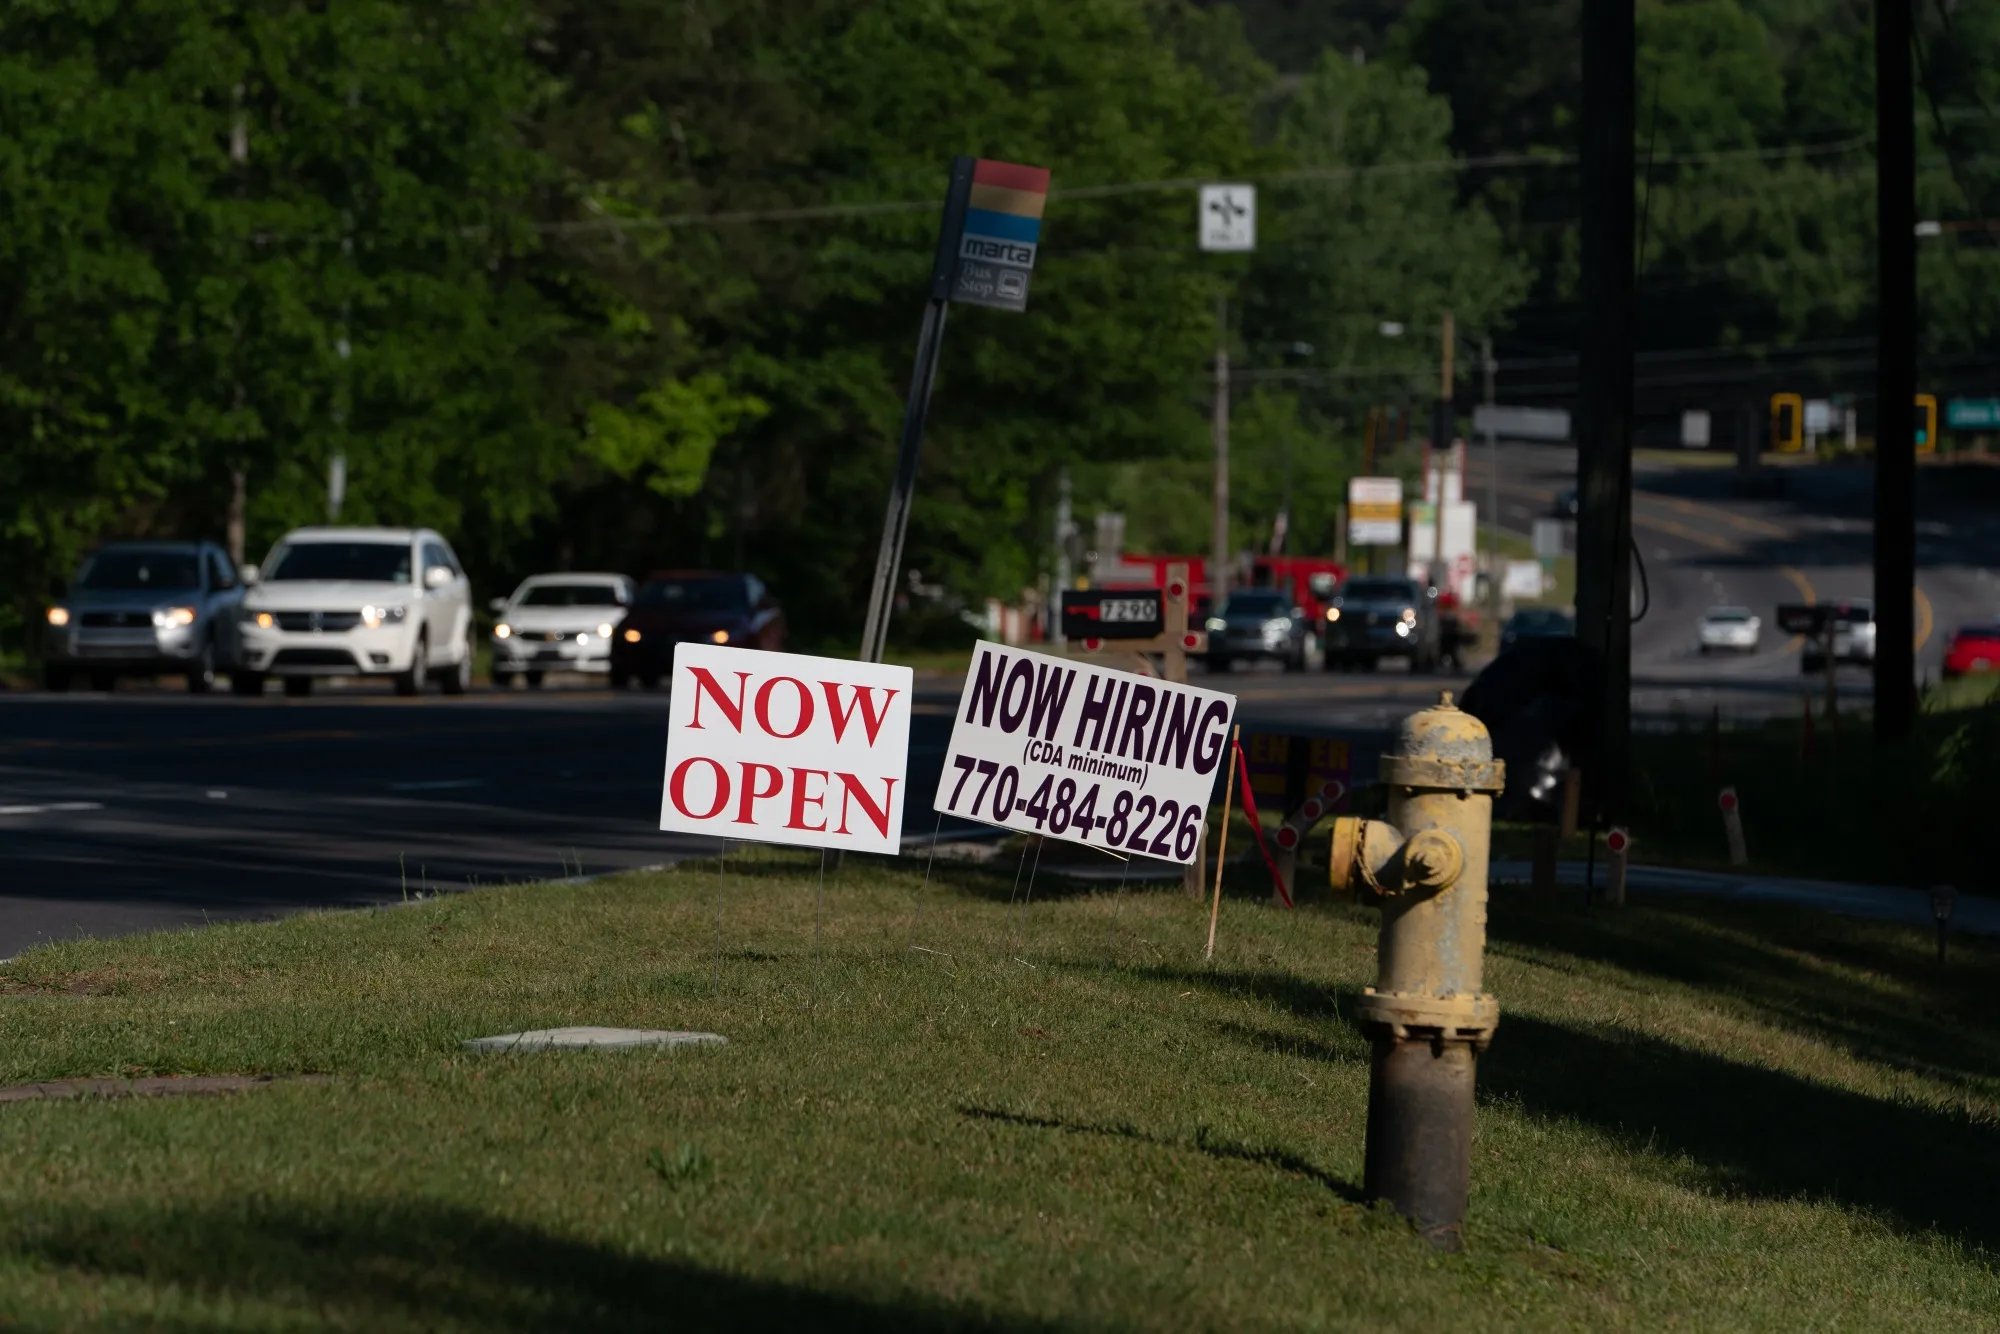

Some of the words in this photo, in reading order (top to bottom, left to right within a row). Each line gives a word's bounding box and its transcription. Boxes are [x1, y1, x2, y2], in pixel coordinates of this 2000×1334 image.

[964, 262, 992, 278] Bus
[965, 239, 1032, 263] marta
[960, 278, 994, 298] Stop
[1104, 603, 1155, 618] 7290
[684, 666, 901, 748] NOW
[965, 650, 1077, 741] NOW
[1073, 674, 1229, 775] HIRING
[1023, 739, 1063, 767] (CDA
[1067, 751, 1149, 790] minimum)
[669, 757, 900, 840] OPEN
[948, 754, 1202, 861] 770-484-8226
